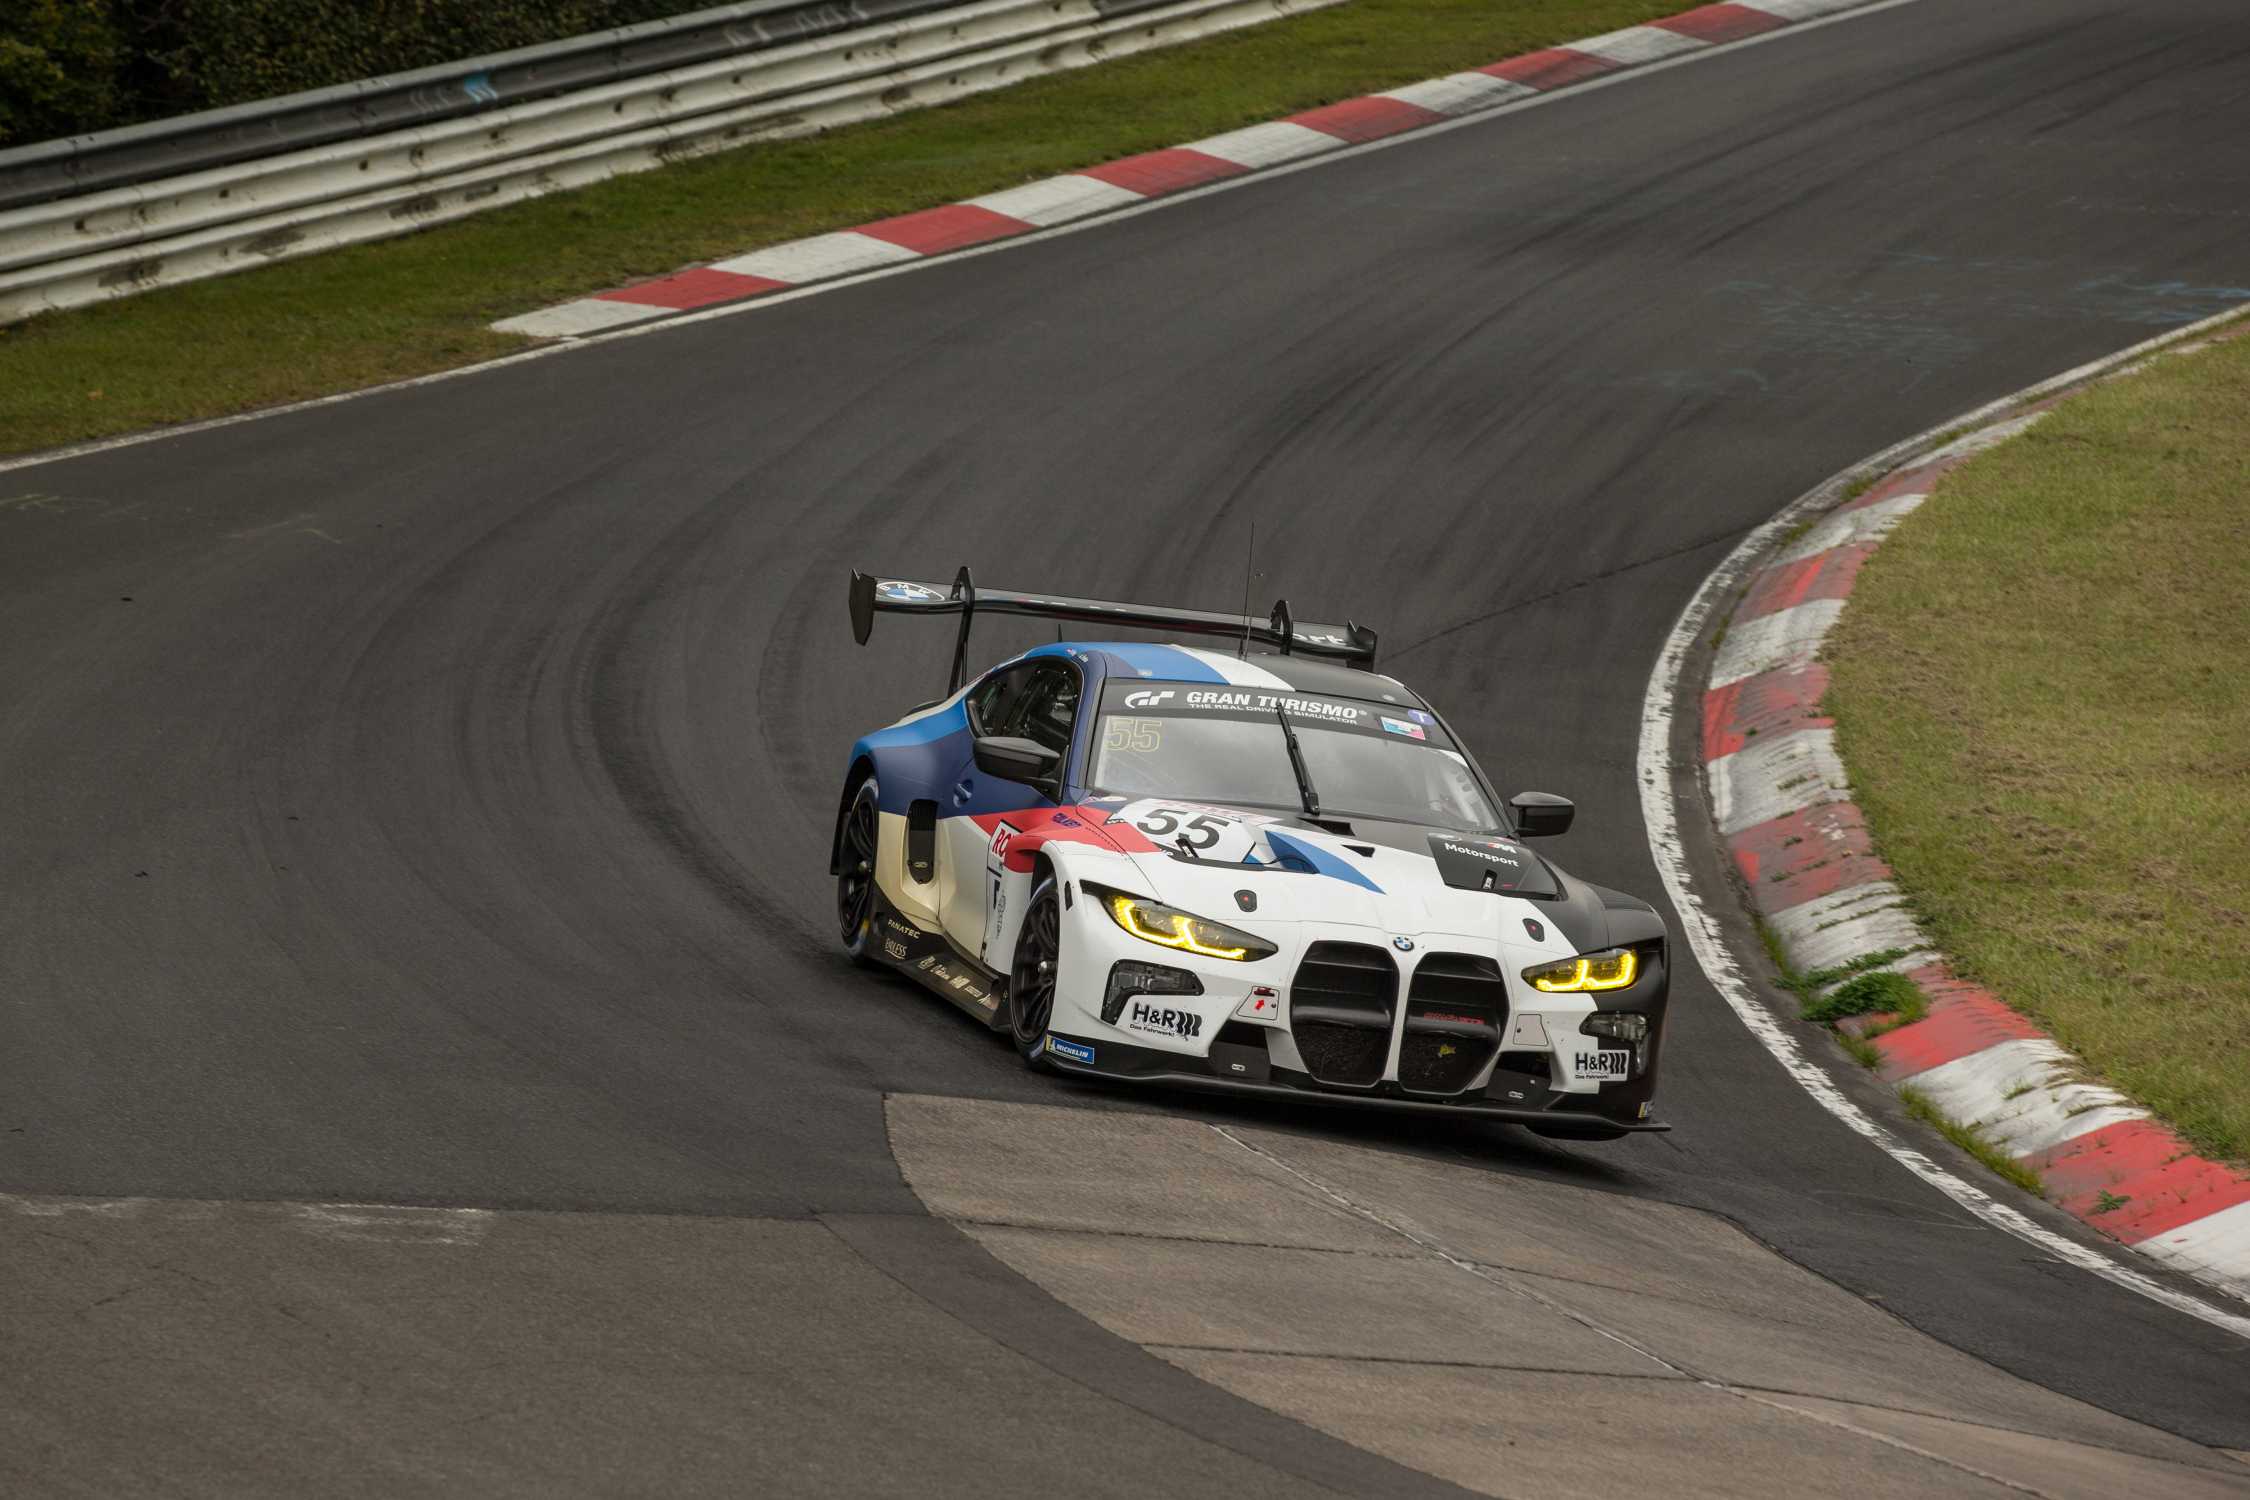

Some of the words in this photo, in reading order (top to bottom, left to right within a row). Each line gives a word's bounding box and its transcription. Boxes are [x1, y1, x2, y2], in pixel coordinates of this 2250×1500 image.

[1186, 691, 1251, 707] GRAN
[1190, 703, 1211, 711] THE
[1213, 704, 1246, 712] REAL
[1294, 711, 1358, 725] SIMULATOR
[1103, 717, 1162, 752] 55
[1137, 809, 1230, 850] 55
[1444, 842, 1519, 867] Motorsport
[888, 919, 921, 940] FANATEC
[1132, 1002, 1176, 1029] H&R
[1055, 1043, 1089, 1058] MICHELIN
[1575, 1052, 1609, 1071] H&R
